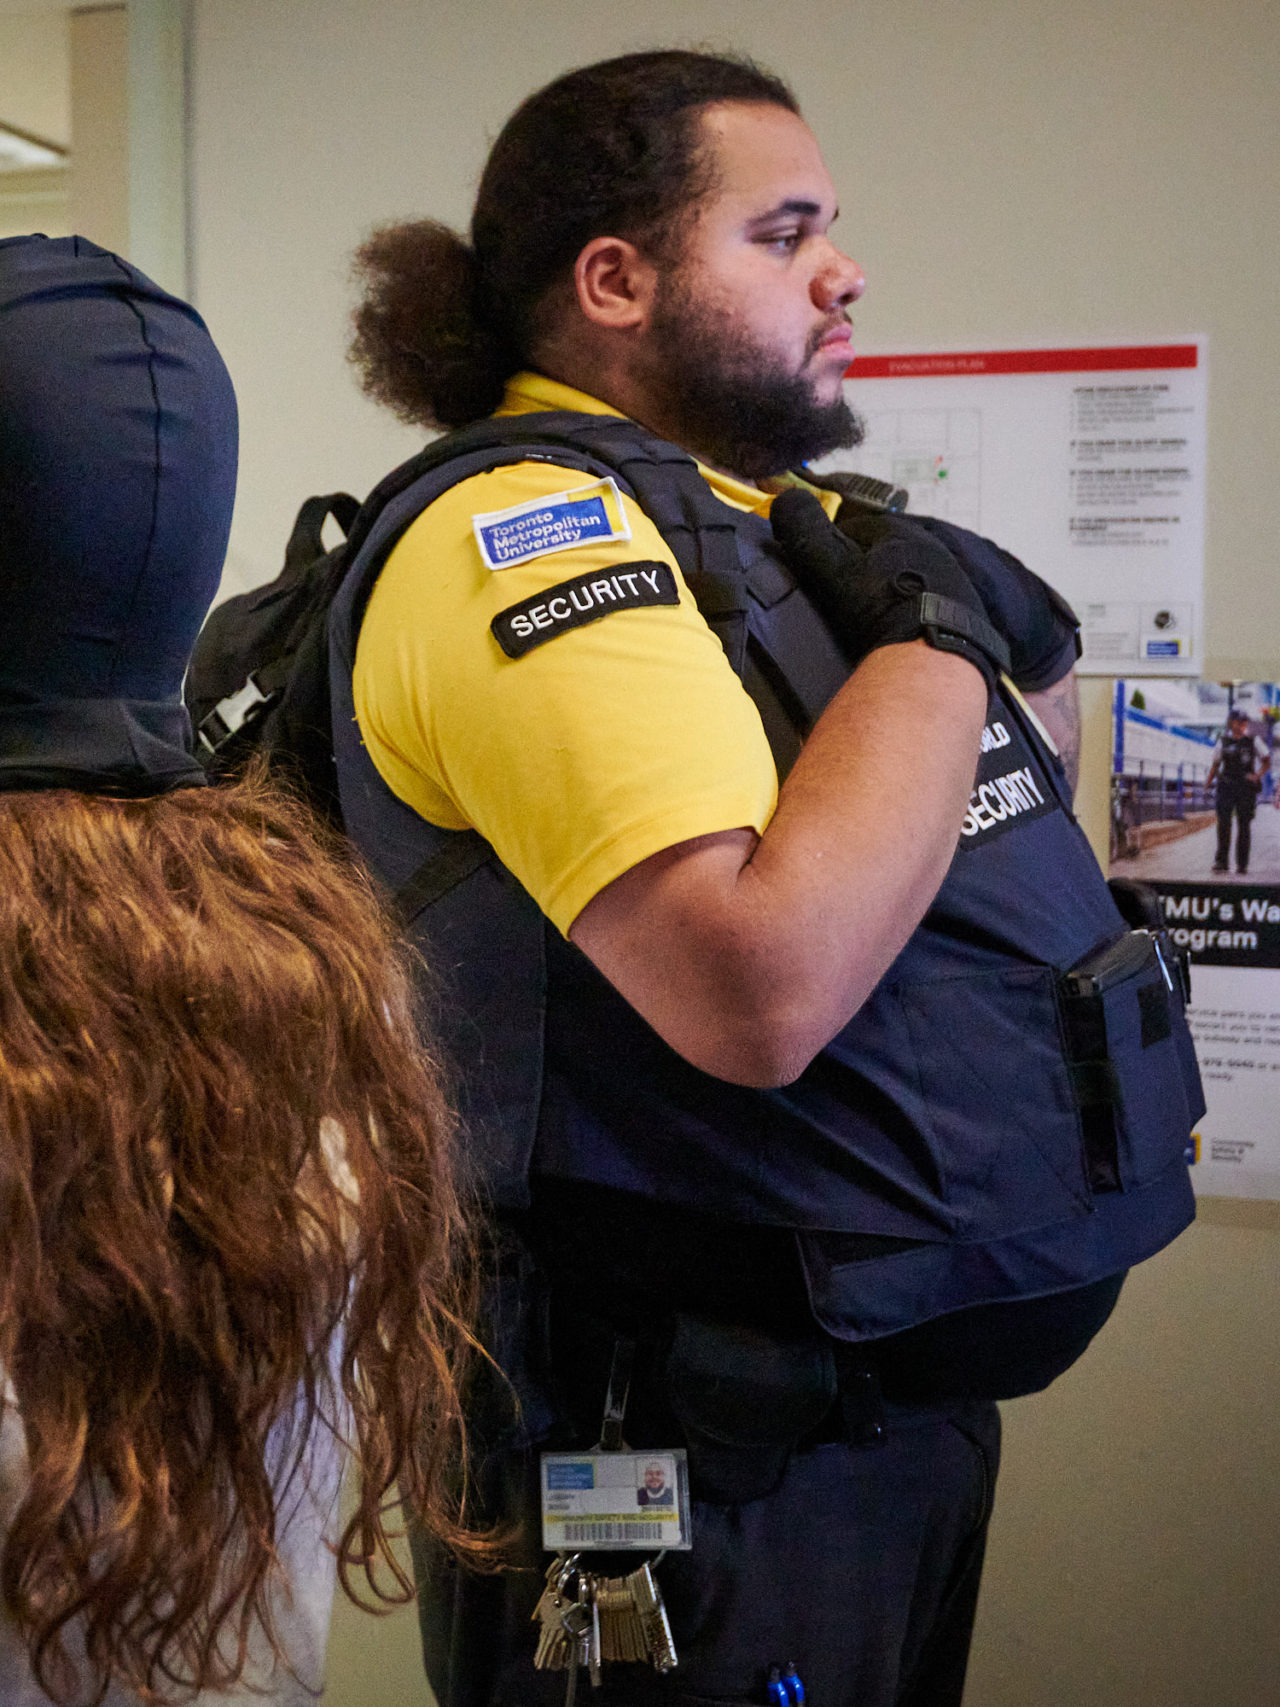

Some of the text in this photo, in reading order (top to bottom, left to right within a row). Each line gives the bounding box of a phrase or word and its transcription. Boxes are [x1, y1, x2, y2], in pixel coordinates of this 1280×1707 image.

[489, 512, 554, 538] Toronto
[492, 515, 601, 550] Metropolitan
[496, 529, 581, 560] University
[510, 569, 661, 637] SECURITY
